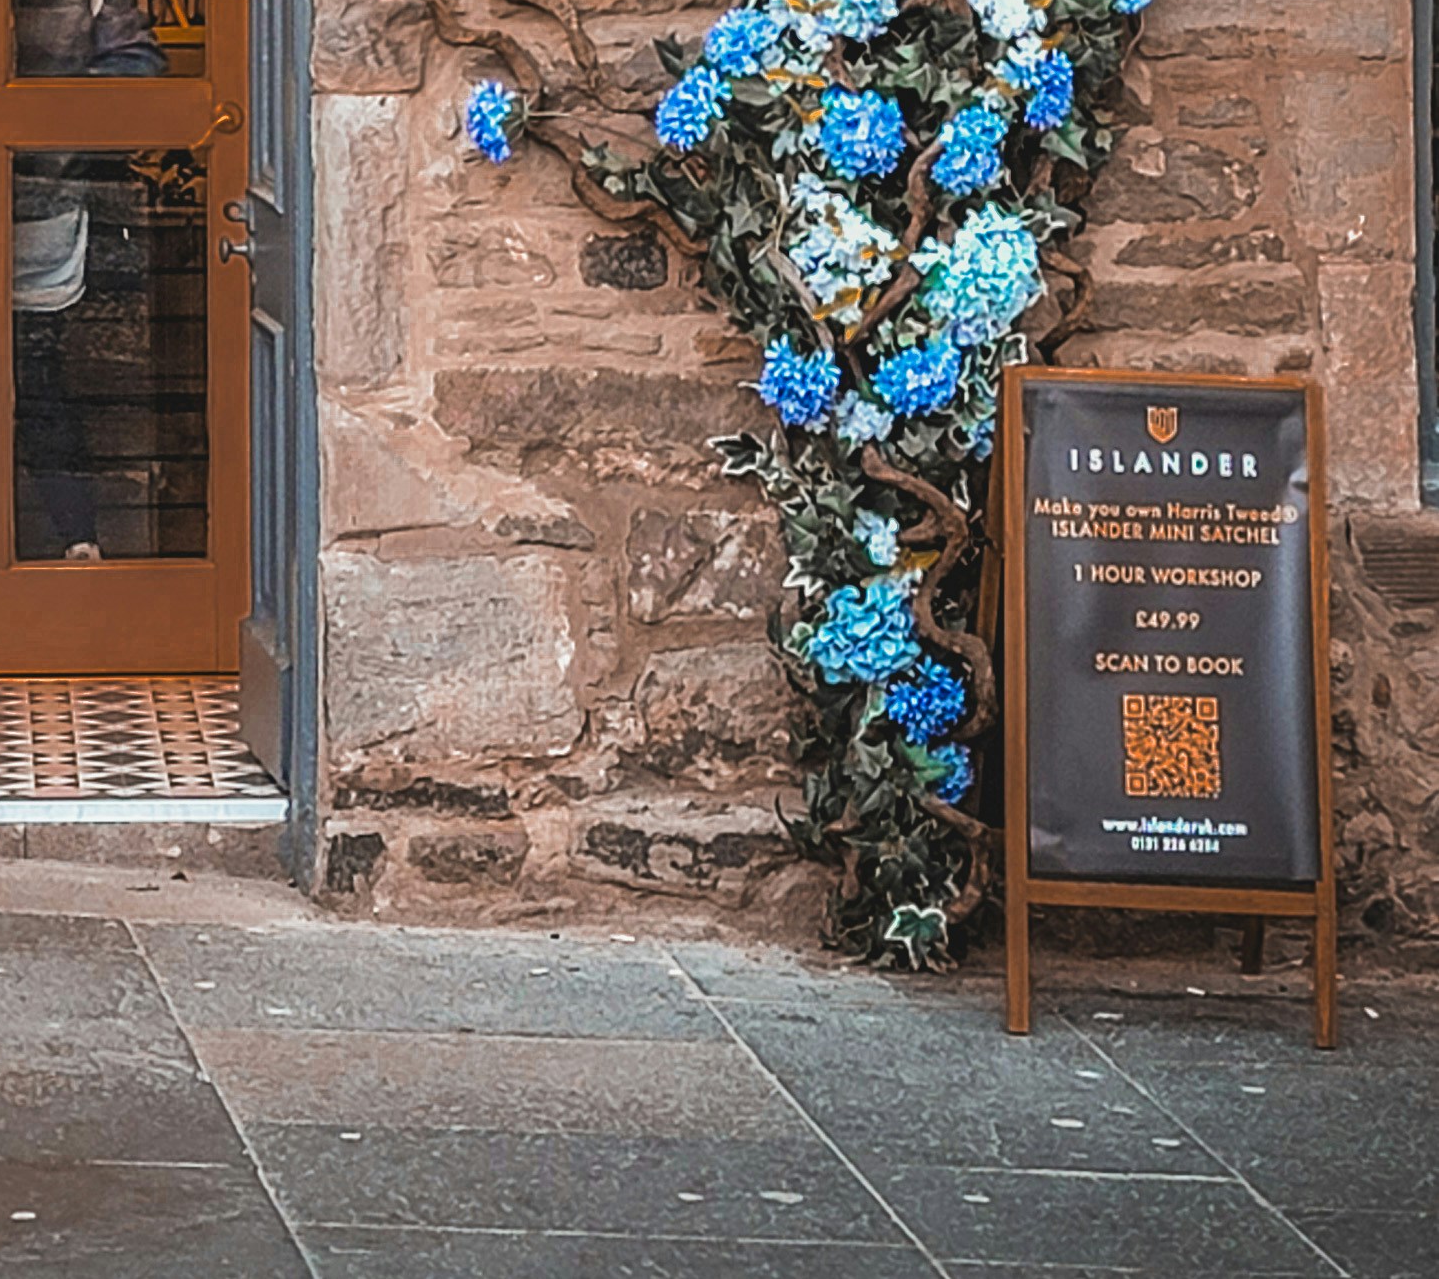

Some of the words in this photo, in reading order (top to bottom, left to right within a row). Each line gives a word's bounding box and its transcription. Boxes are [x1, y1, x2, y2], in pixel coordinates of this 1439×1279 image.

[1070, 449, 1257, 478] ISLANDER
[1033, 497, 1082, 516] Make
[1088, 503, 1120, 521] you
[1125, 505, 1161, 519] own
[1167, 502, 1221, 522] Harris
[1051, 520, 1143, 540] ISLANDER
[1149, 523, 1194, 541] MINI
[1200, 525, 1280, 545] SATCHEL
[1073, 563, 1083, 582] 1
[1090, 564, 1146, 584] HOUR
[1151, 566, 1262, 588] WORKSHOP
[1135, 610, 1200, 630] £49.99
[1095, 652, 1149, 672] SCAN
[1154, 654, 1181, 674] TO
[1186, 656, 1244, 676] BOOK
